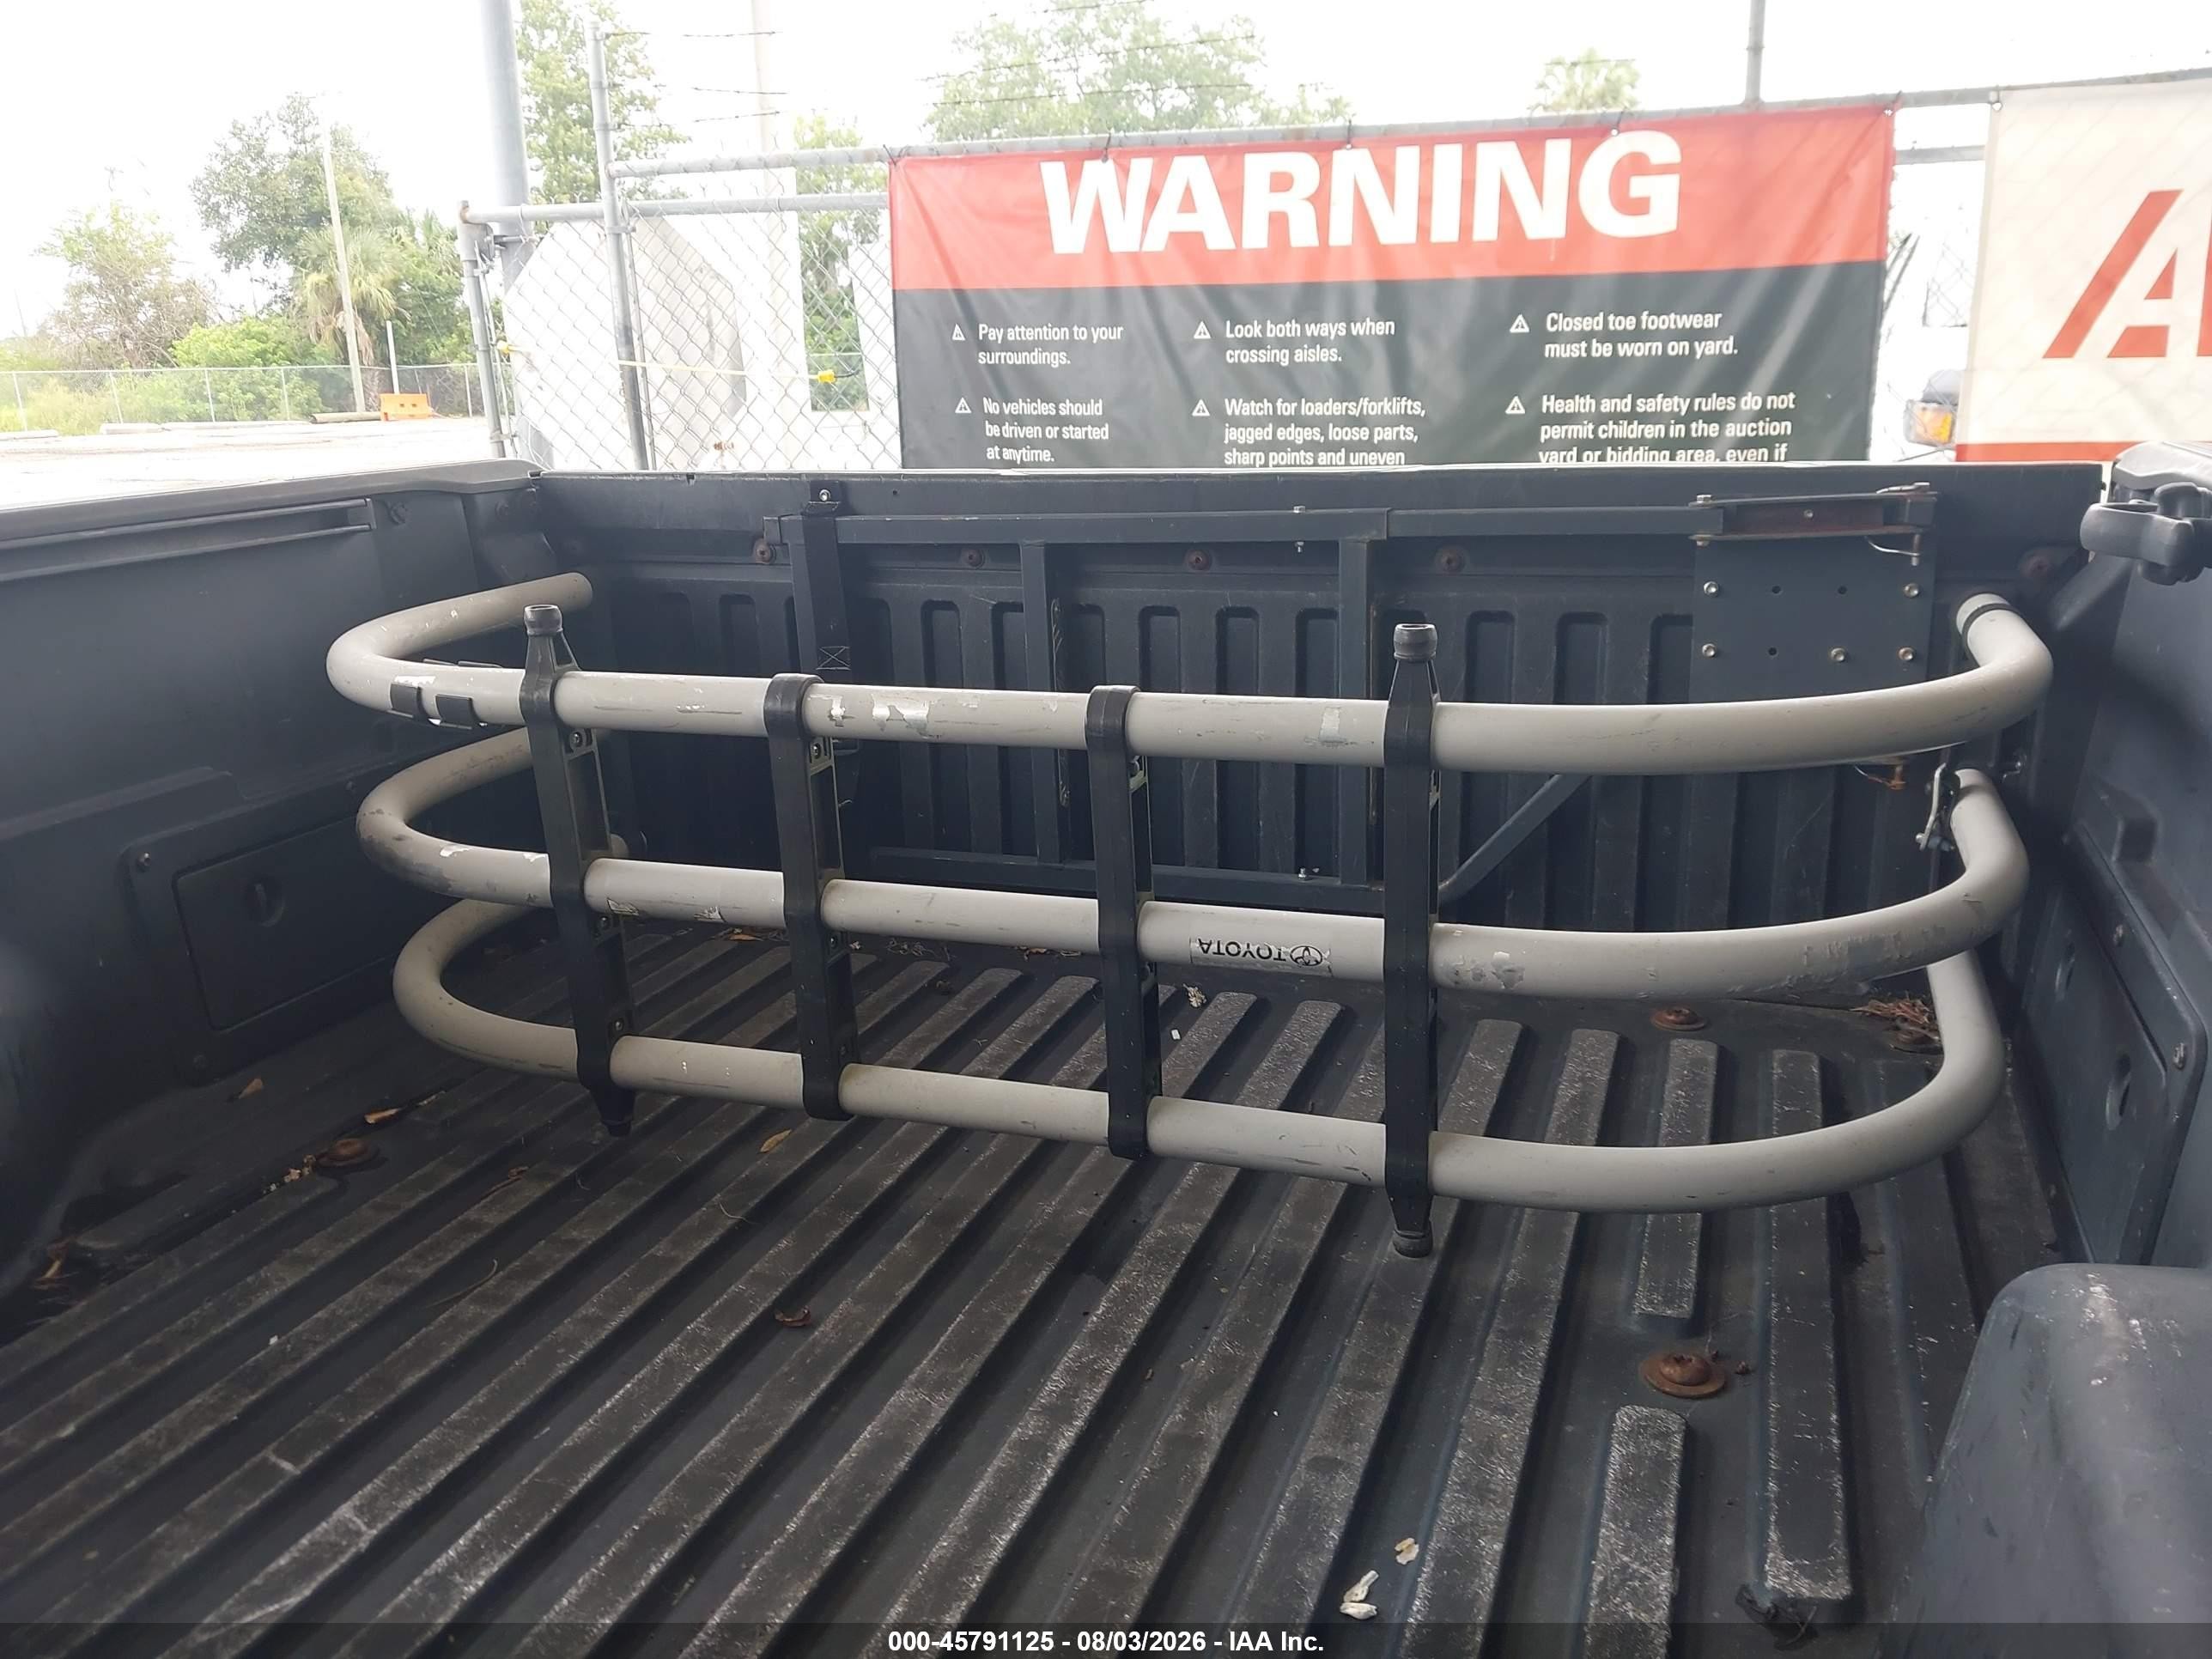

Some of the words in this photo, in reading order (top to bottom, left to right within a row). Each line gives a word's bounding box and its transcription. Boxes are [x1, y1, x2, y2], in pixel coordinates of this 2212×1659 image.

[1040, 131, 1681, 255] WARNING
[1225, 319, 1262, 338] Look
[1266, 319, 1302, 338] both
[1304, 322, 1347, 340] ways
[1351, 317, 1395, 336] when
[1546, 313, 1603, 332] Closed
[1607, 313, 1636, 331] toe
[1641, 312, 1723, 330] footwear
[978, 323, 1003, 343] Pay
[1007, 323, 1068, 342] attention
[1072, 325, 1086, 340] to
[1091, 325, 1123, 343] your
[1225, 346, 1289, 367] crossing
[1294, 345, 1342, 363] aisles.
[1545, 341, 1588, 358] must
[1591, 339, 1613, 357] be
[1617, 341, 1662, 356] worn
[1667, 341, 1690, 356] on
[1693, 337, 1738, 358] yard.
[978, 349, 1071, 368] surroundings.
[983, 398, 1000, 415] No
[1002, 398, 1056, 416] vehicles
[1059, 399, 1102, 416] should
[1224, 398, 1272, 416] Watch
[1276, 398, 1297, 416] for
[1301, 396, 1425, 417] loaders/forklifts,
[1542, 395, 1596, 413] Health
[1600, 395, 1632, 413] and
[1636, 394, 1690, 416] safety
[1693, 393, 1736, 411] rules
[1741, 392, 1762, 410] do
[1766, 392, 1796, 409] not
[986, 422, 1000, 438] be
[1001, 422, 1042, 439] driven
[1045, 424, 1060, 440] or
[1062, 423, 1109, 440] started
[1224, 424, 1273, 444] jagged
[1277, 424, 1324, 443] edges,
[1328, 424, 1370, 441] loose
[1374, 424, 1419, 443] parts,
[1540, 422, 1594, 444] permit
[1598, 421, 1665, 439] children
[1669, 422, 1686, 439] in
[1690, 420, 1720, 438] the
[1725, 419, 1792, 437] auction
[987, 445, 1000, 461] at
[1002, 446, 1054, 465] anytime.
[1224, 449, 1265, 468] sharp
[1268, 448, 1314, 468] points
[1317, 448, 1345, 466] and
[1349, 450, 1405, 466] uneven
[1539, 447, 1577, 462] yard
[1583, 450, 1601, 462] or
[1607, 446, 1670, 462] bidding
[1726, 447, 1769, 462] even
[1775, 443, 1788, 461] if
[1198, 938, 1286, 962] TOYOTA
